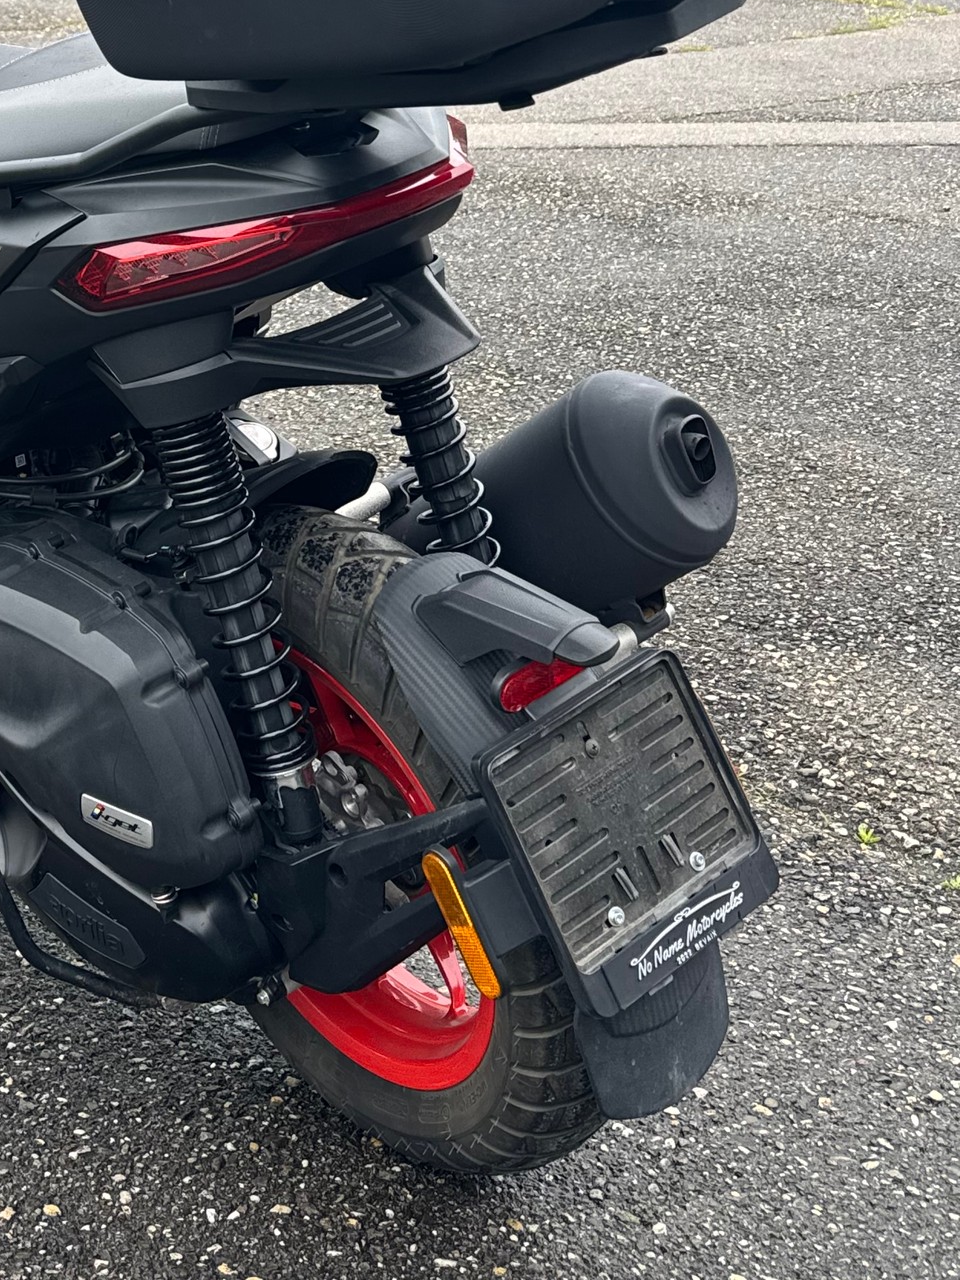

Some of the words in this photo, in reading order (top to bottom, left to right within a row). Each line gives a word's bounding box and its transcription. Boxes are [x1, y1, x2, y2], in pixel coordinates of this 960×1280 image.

[637, 960, 653, 981] No
[653, 939, 685, 969] Name
[685, 891, 744, 948] Motorcycles
